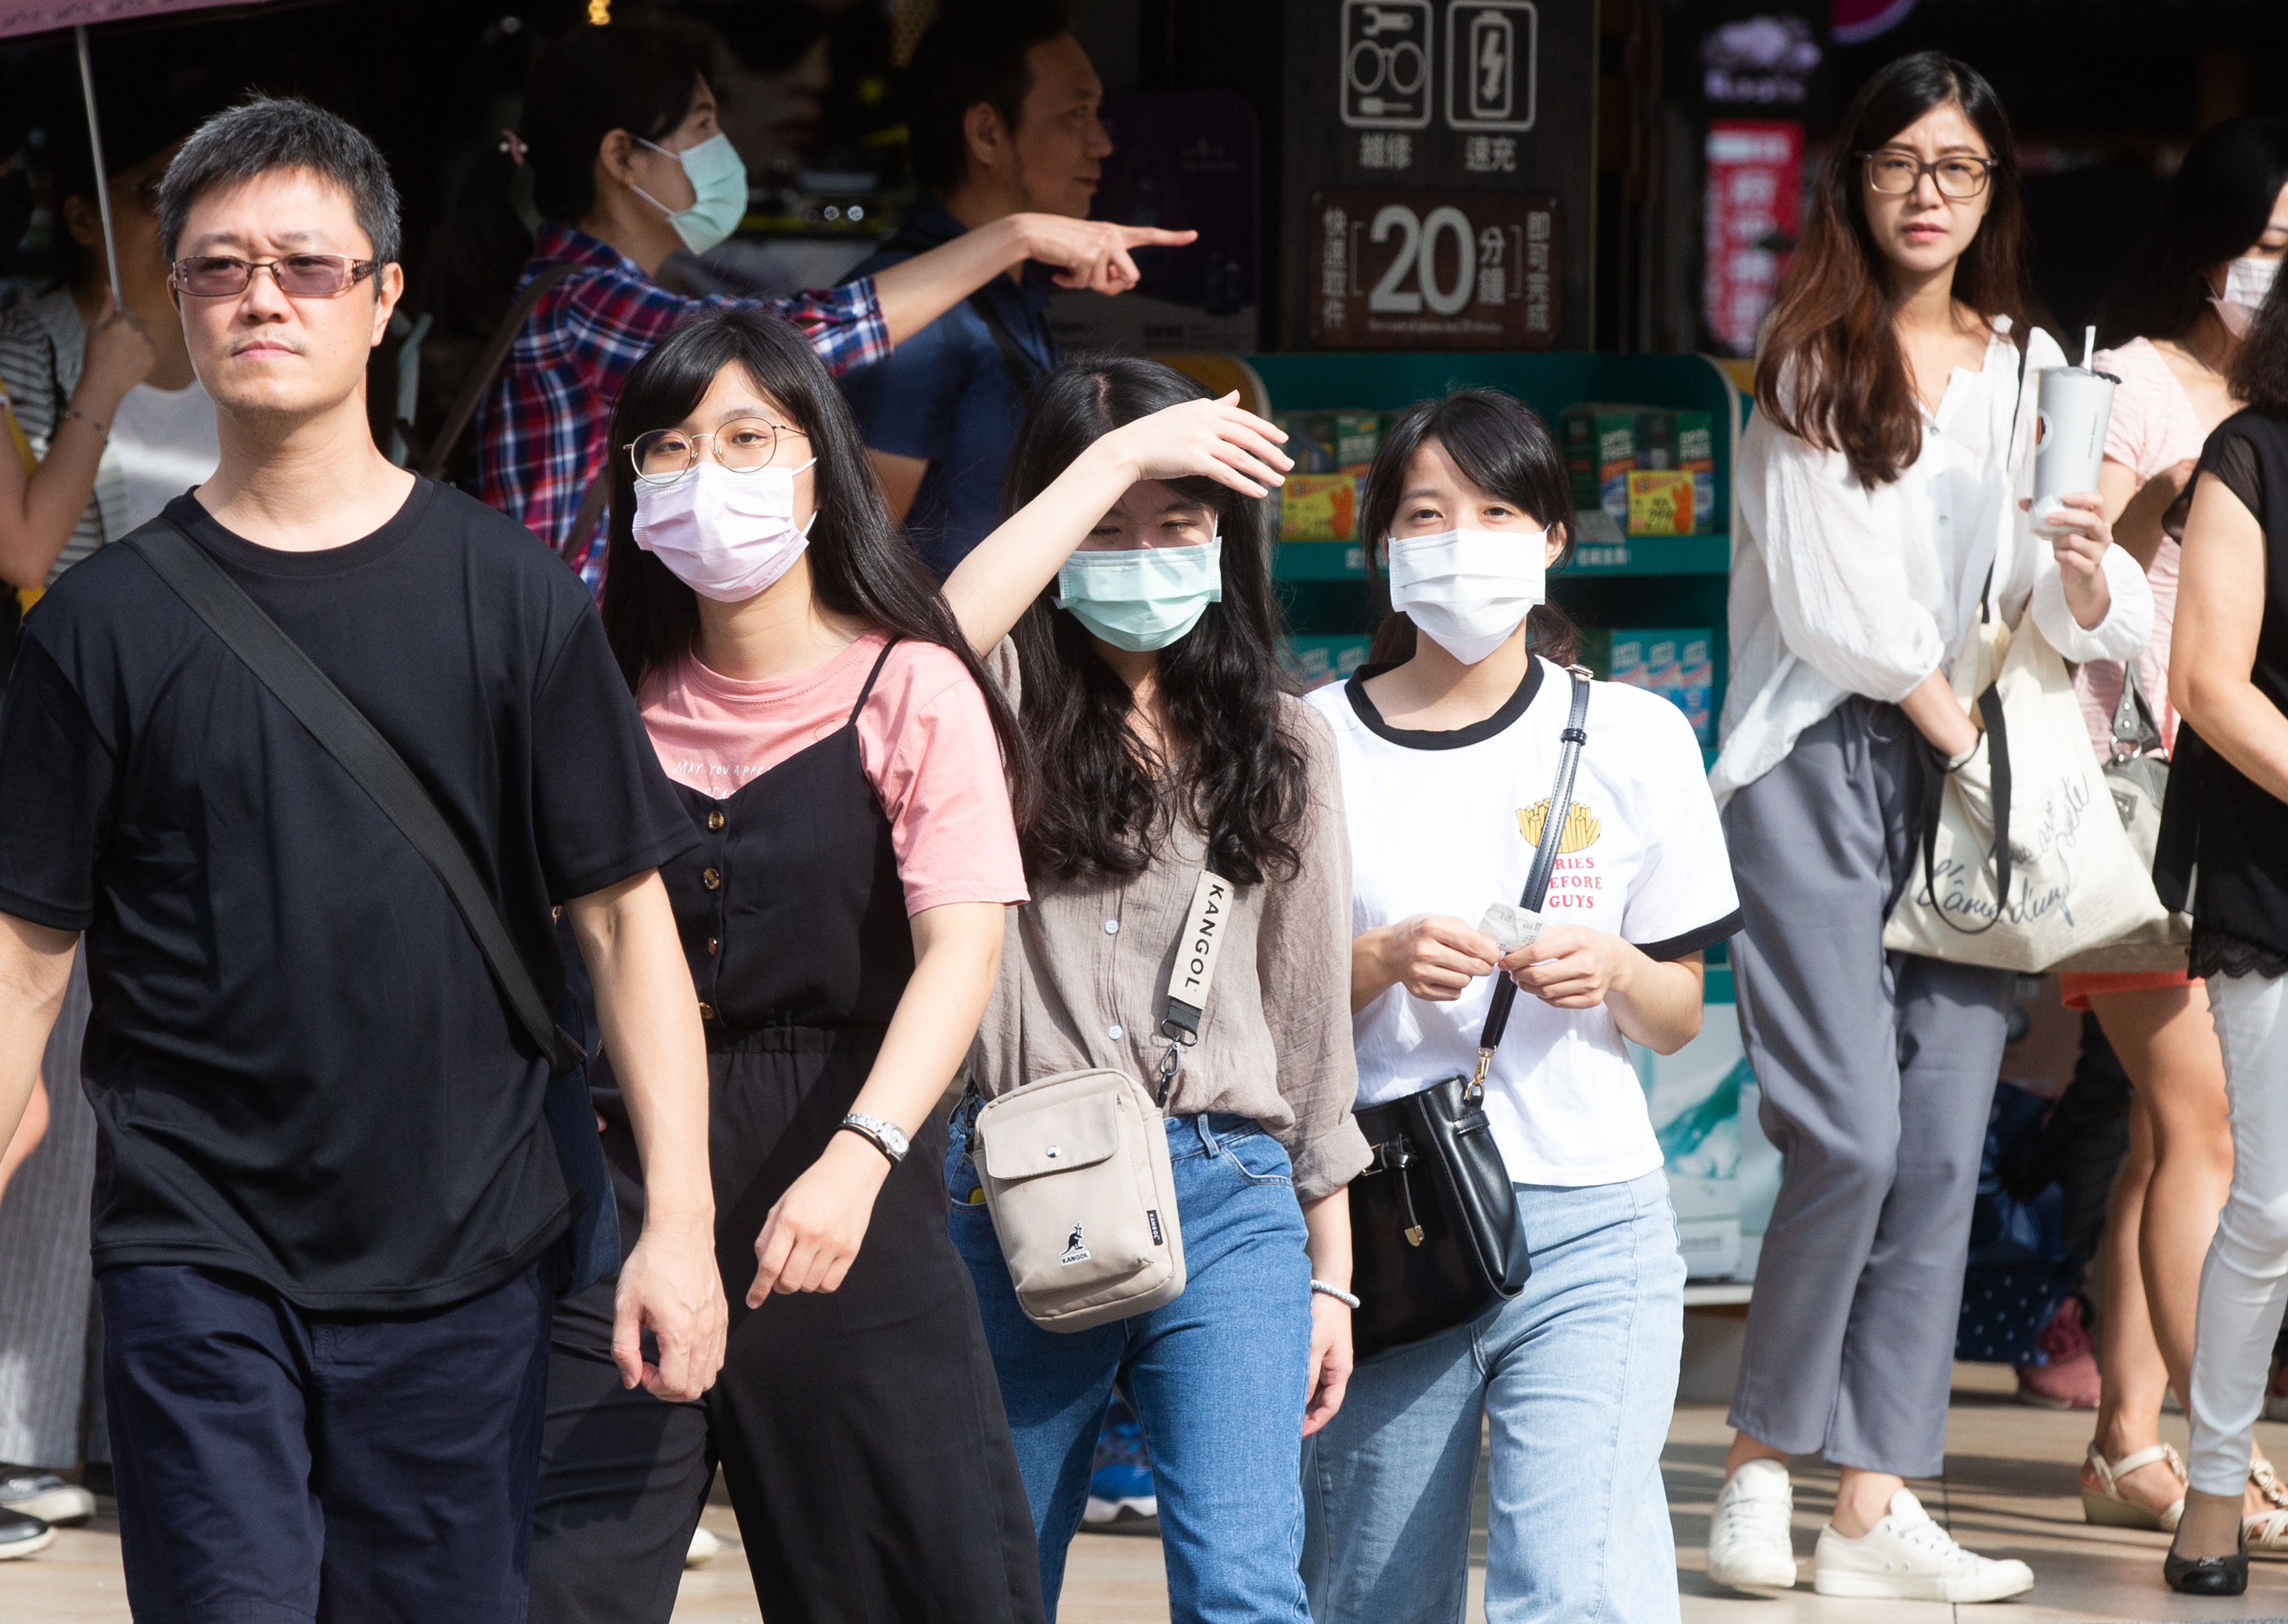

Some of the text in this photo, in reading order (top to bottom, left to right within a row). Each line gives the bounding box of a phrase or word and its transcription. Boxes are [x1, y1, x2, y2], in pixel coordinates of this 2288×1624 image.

[1369, 204, 1477, 315] 20
[671, 760, 703, 775] MAY
[709, 763, 730, 776] YOU
[1554, 857, 1595, 871] RIES
[1549, 875, 1603, 889] EFORE
[1549, 895, 1594, 908] GUYS
[1185, 883, 1225, 988] KANGOL
[1149, 1213, 1160, 1241] KANGOL
[1061, 1252, 1089, 1265] KANGOL
